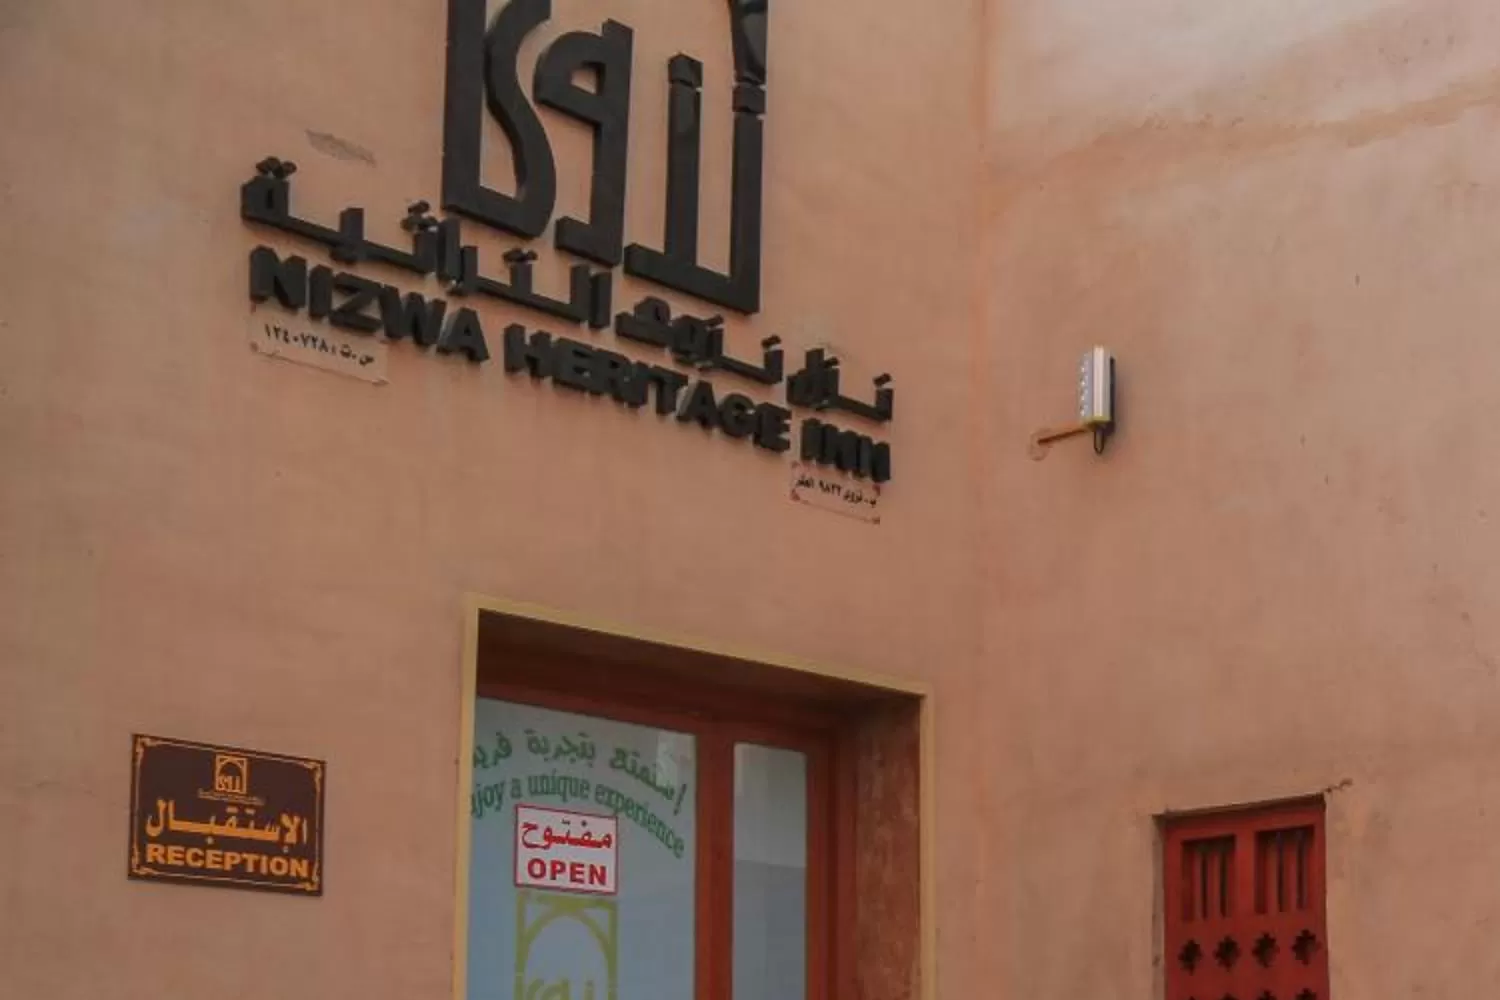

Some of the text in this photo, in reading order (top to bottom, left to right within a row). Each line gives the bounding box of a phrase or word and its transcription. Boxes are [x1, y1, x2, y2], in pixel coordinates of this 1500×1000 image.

[250, 244, 890, 482] NIZWA HERITAGE INN
[510, 776, 522, 799] a
[528, 768, 590, 803] unique
[595, 783, 685, 860] experience
[520, 818, 613, 850] مفتوح
[146, 843, 309, 878] RECEPTION
[527, 858, 607, 886] OPEN
